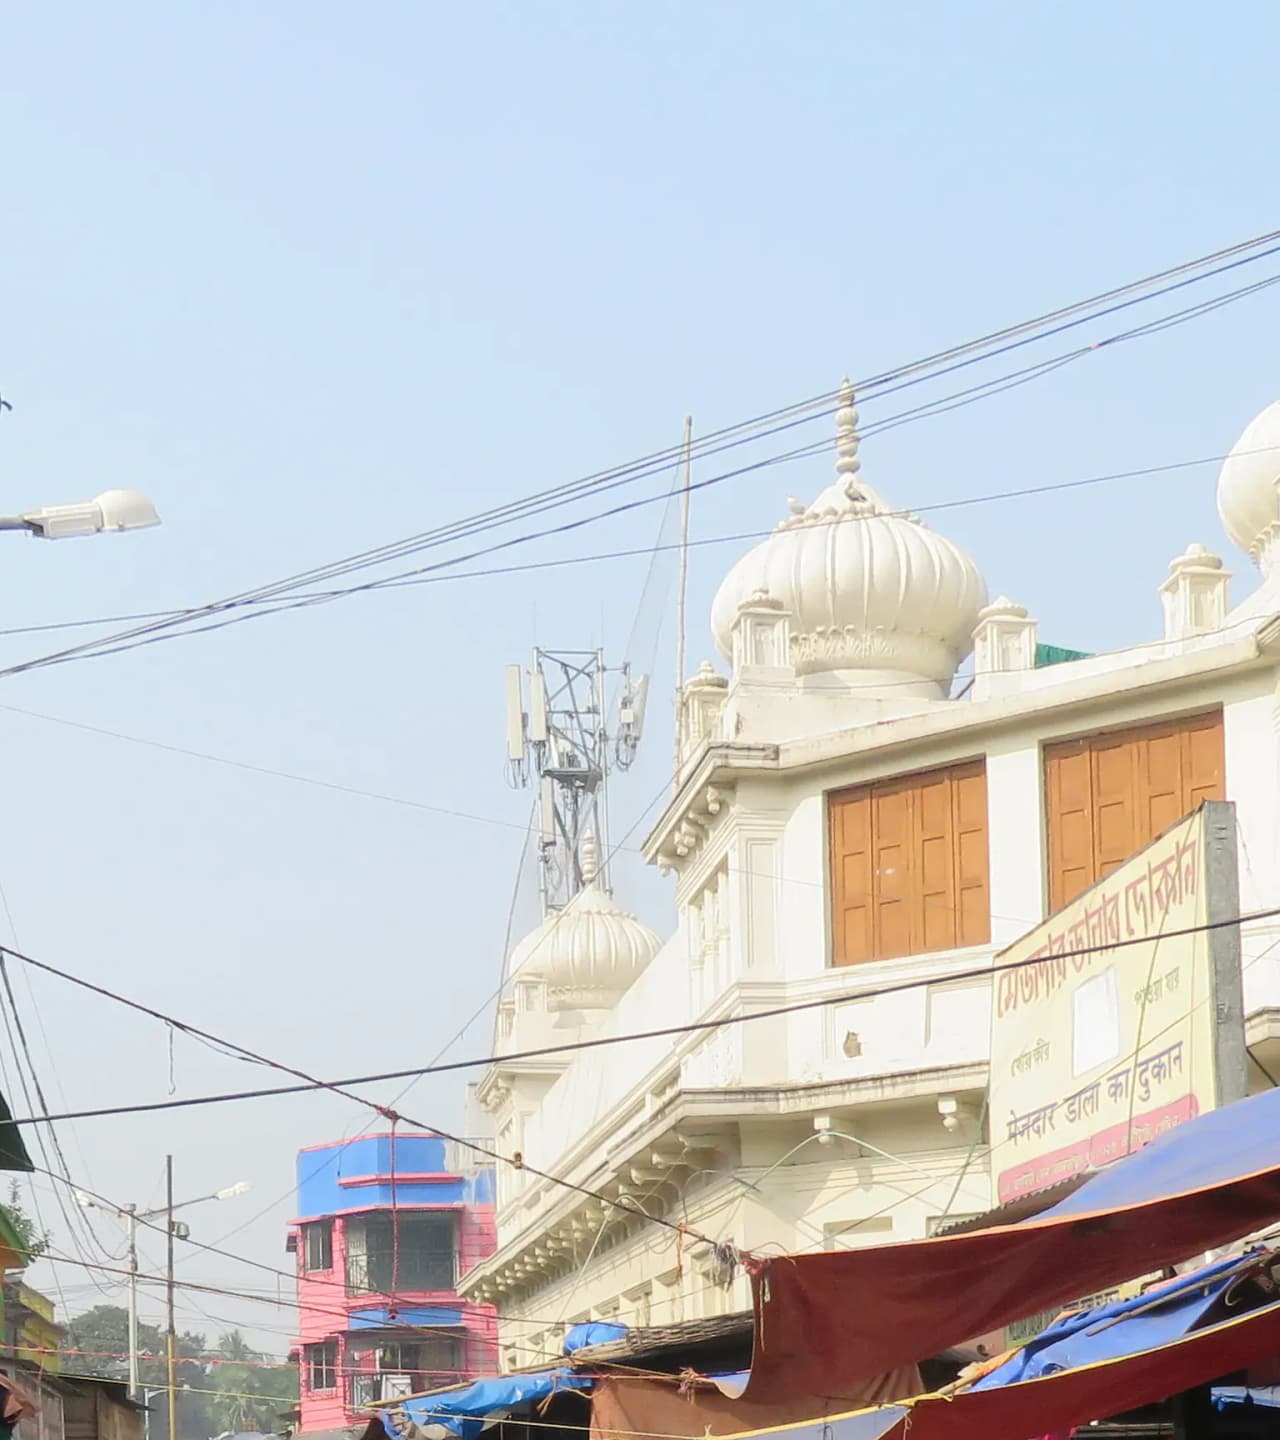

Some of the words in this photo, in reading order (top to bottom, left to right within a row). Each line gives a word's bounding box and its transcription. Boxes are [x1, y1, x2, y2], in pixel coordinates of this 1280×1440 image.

[1064, 1082, 1102, 1124] डाला
[1107, 1067, 1132, 1104] का
[1136, 1041, 1184, 1102] दुकान
